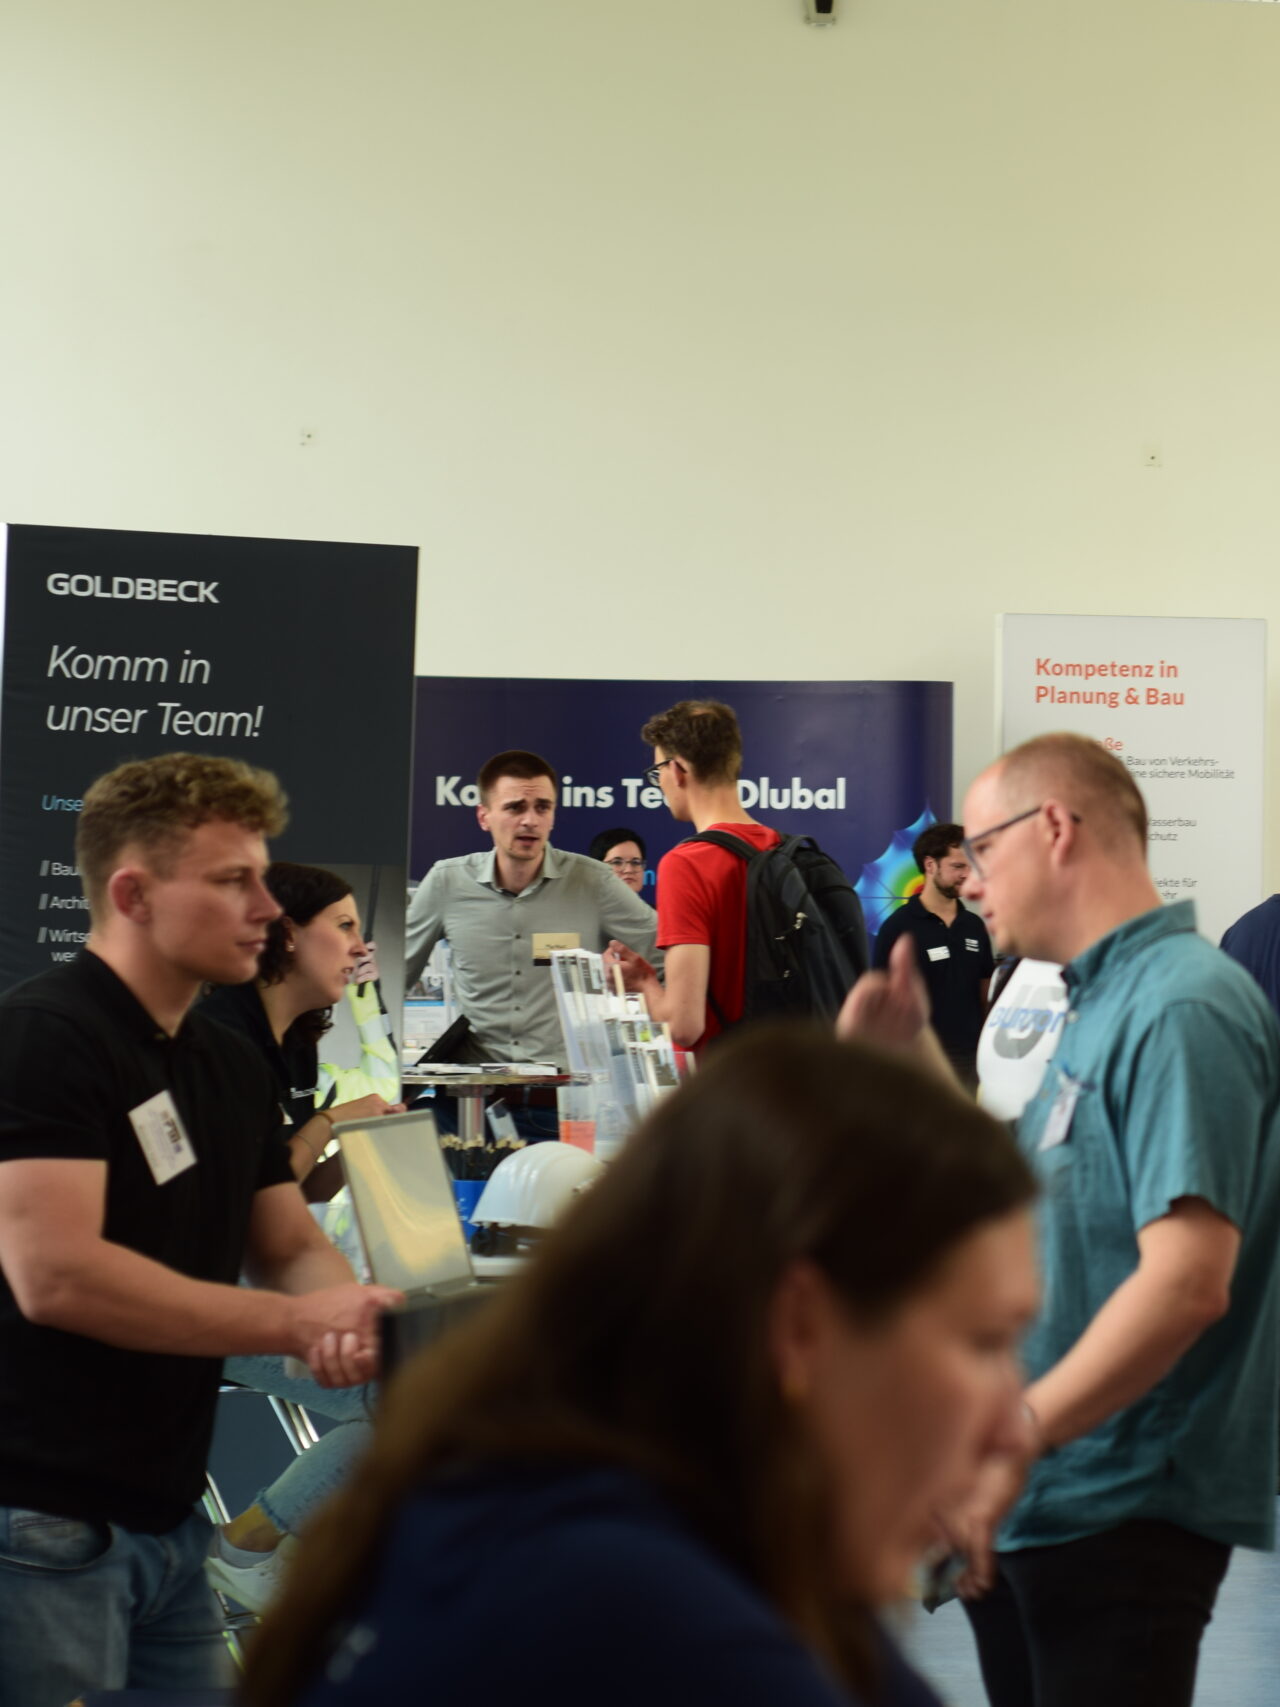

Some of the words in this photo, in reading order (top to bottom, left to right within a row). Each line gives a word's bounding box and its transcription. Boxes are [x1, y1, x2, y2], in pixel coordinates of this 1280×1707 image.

[46, 572, 220, 604] GOLDBECK
[47, 644, 168, 682] Komm
[180, 650, 210, 684] in
[1035, 658, 1154, 680] Kompetenz
[1159, 660, 1178, 678] in
[1035, 685, 1119, 708] Planung
[1125, 687, 1140, 705] &
[1145, 687, 1185, 706] Bau
[46, 703, 147, 735] unser
[157, 702, 264, 738] Team!
[1149, 757, 1168, 766] von
[1170, 756, 1219, 767] Verkehrs-
[1149, 769, 1185, 779] sichere
[1187, 769, 1235, 779] Mobilität
[561, 776, 614, 808] ins
[736, 777, 847, 810] Dlubal
[1150, 817, 1198, 827] asserbau
[1147, 832, 1179, 841] chutz
